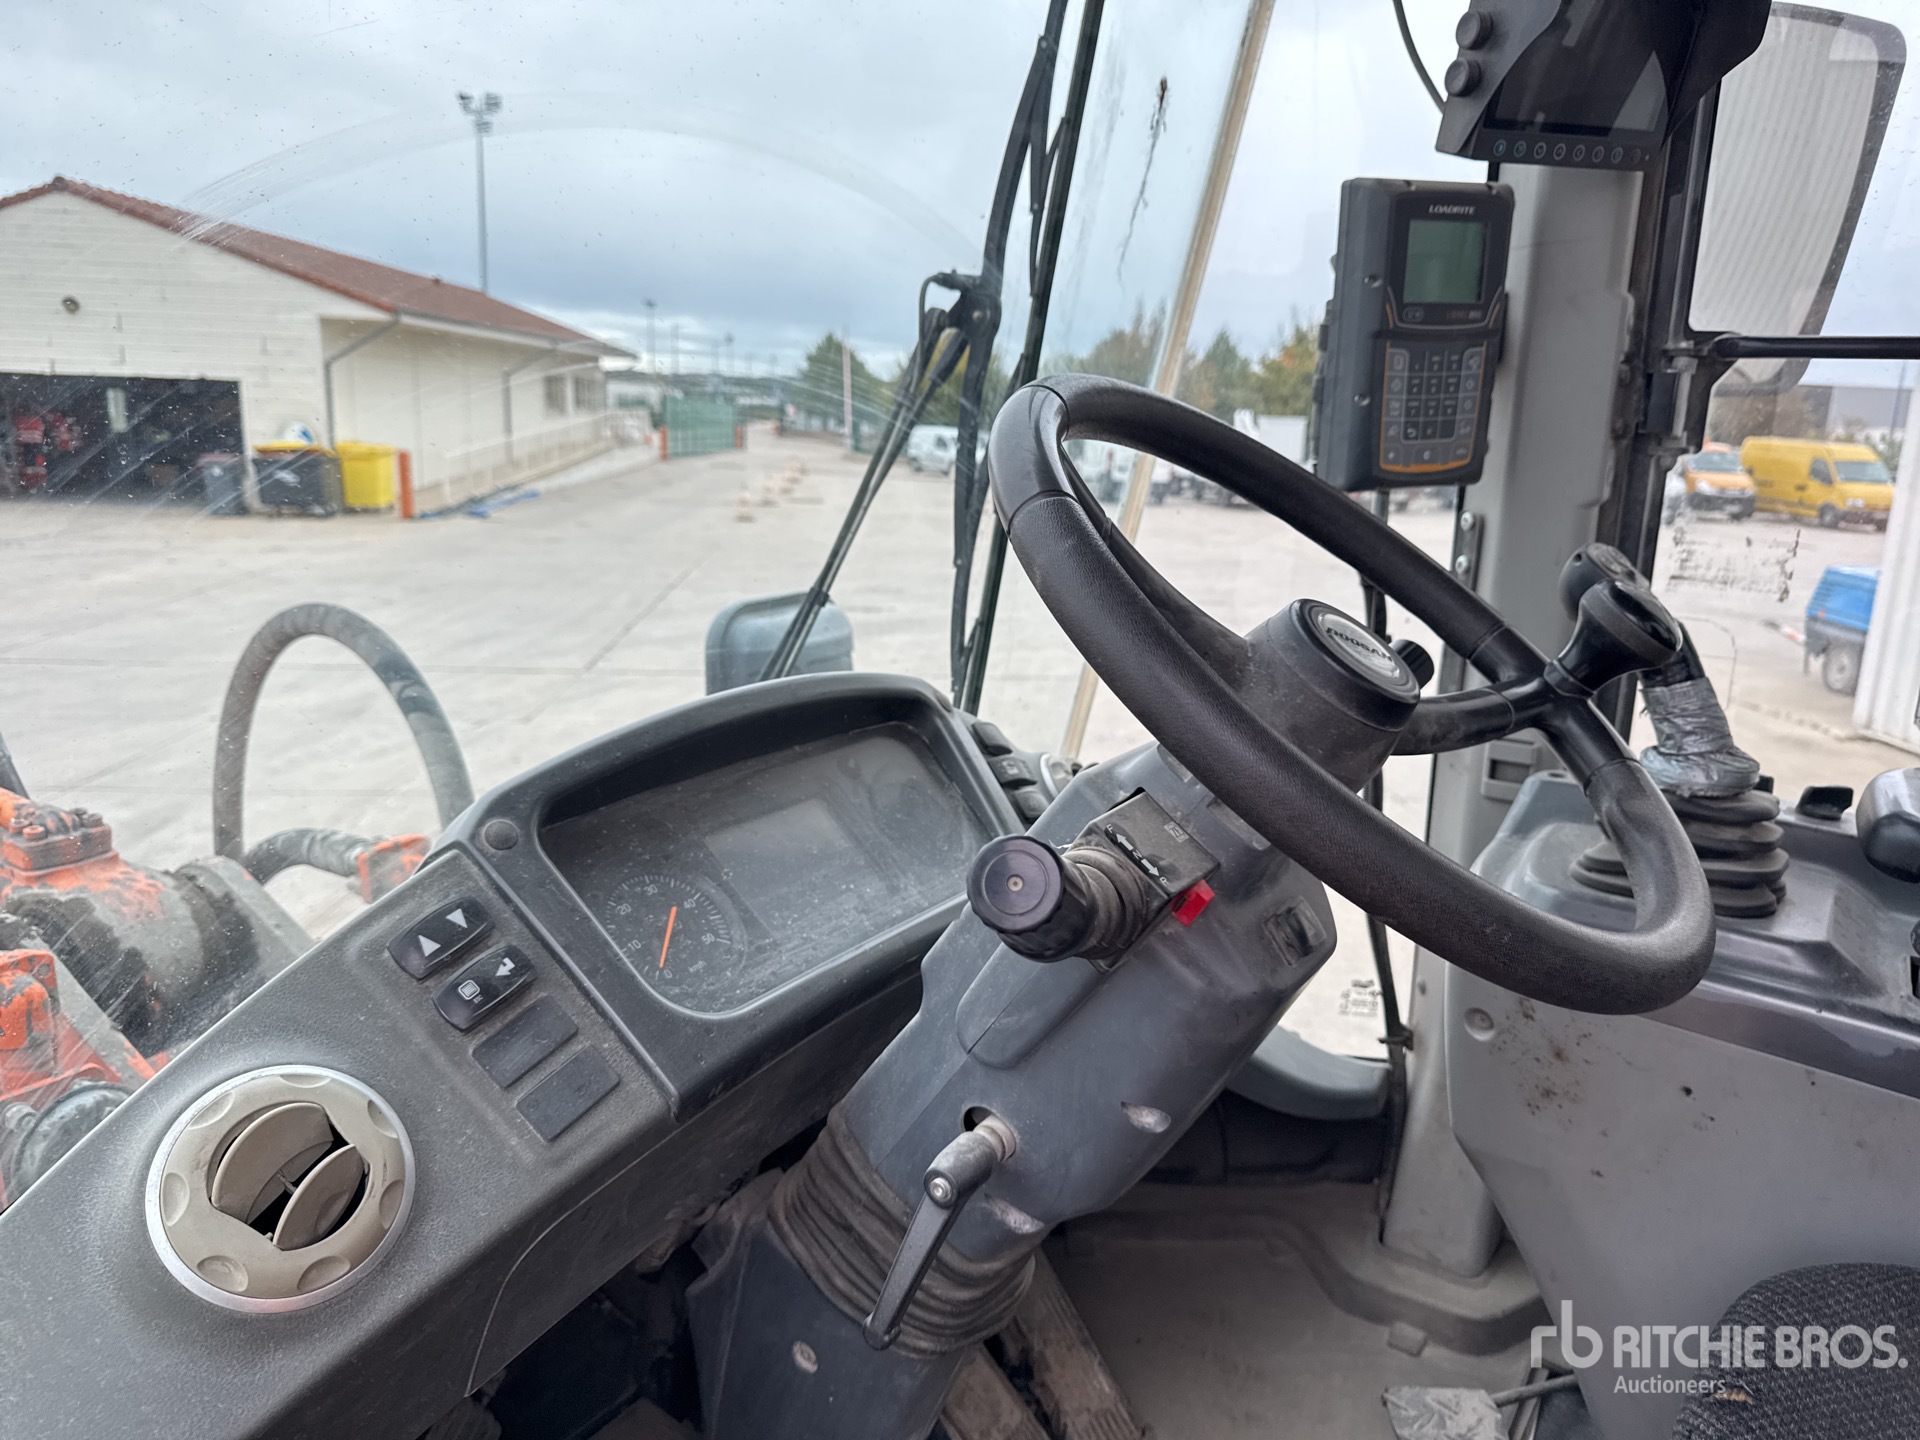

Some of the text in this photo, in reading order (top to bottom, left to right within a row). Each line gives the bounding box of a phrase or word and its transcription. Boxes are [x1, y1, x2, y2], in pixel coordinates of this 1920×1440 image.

[1428, 204, 1476, 215] LOADRITE
[1326, 627, 1393, 662] DOOSAN
[1106, 824, 1113, 834] F
[1132, 850, 1142, 859] N
[1159, 876, 1169, 887] R
[644, 884, 658, 896] 30
[616, 902, 631, 915] 20
[684, 899, 696, 909] 40
[701, 932, 715, 945] 50
[628, 939, 642, 950] 10
[688, 960, 707, 973] km/h
[664, 969, 673, 979] 0
